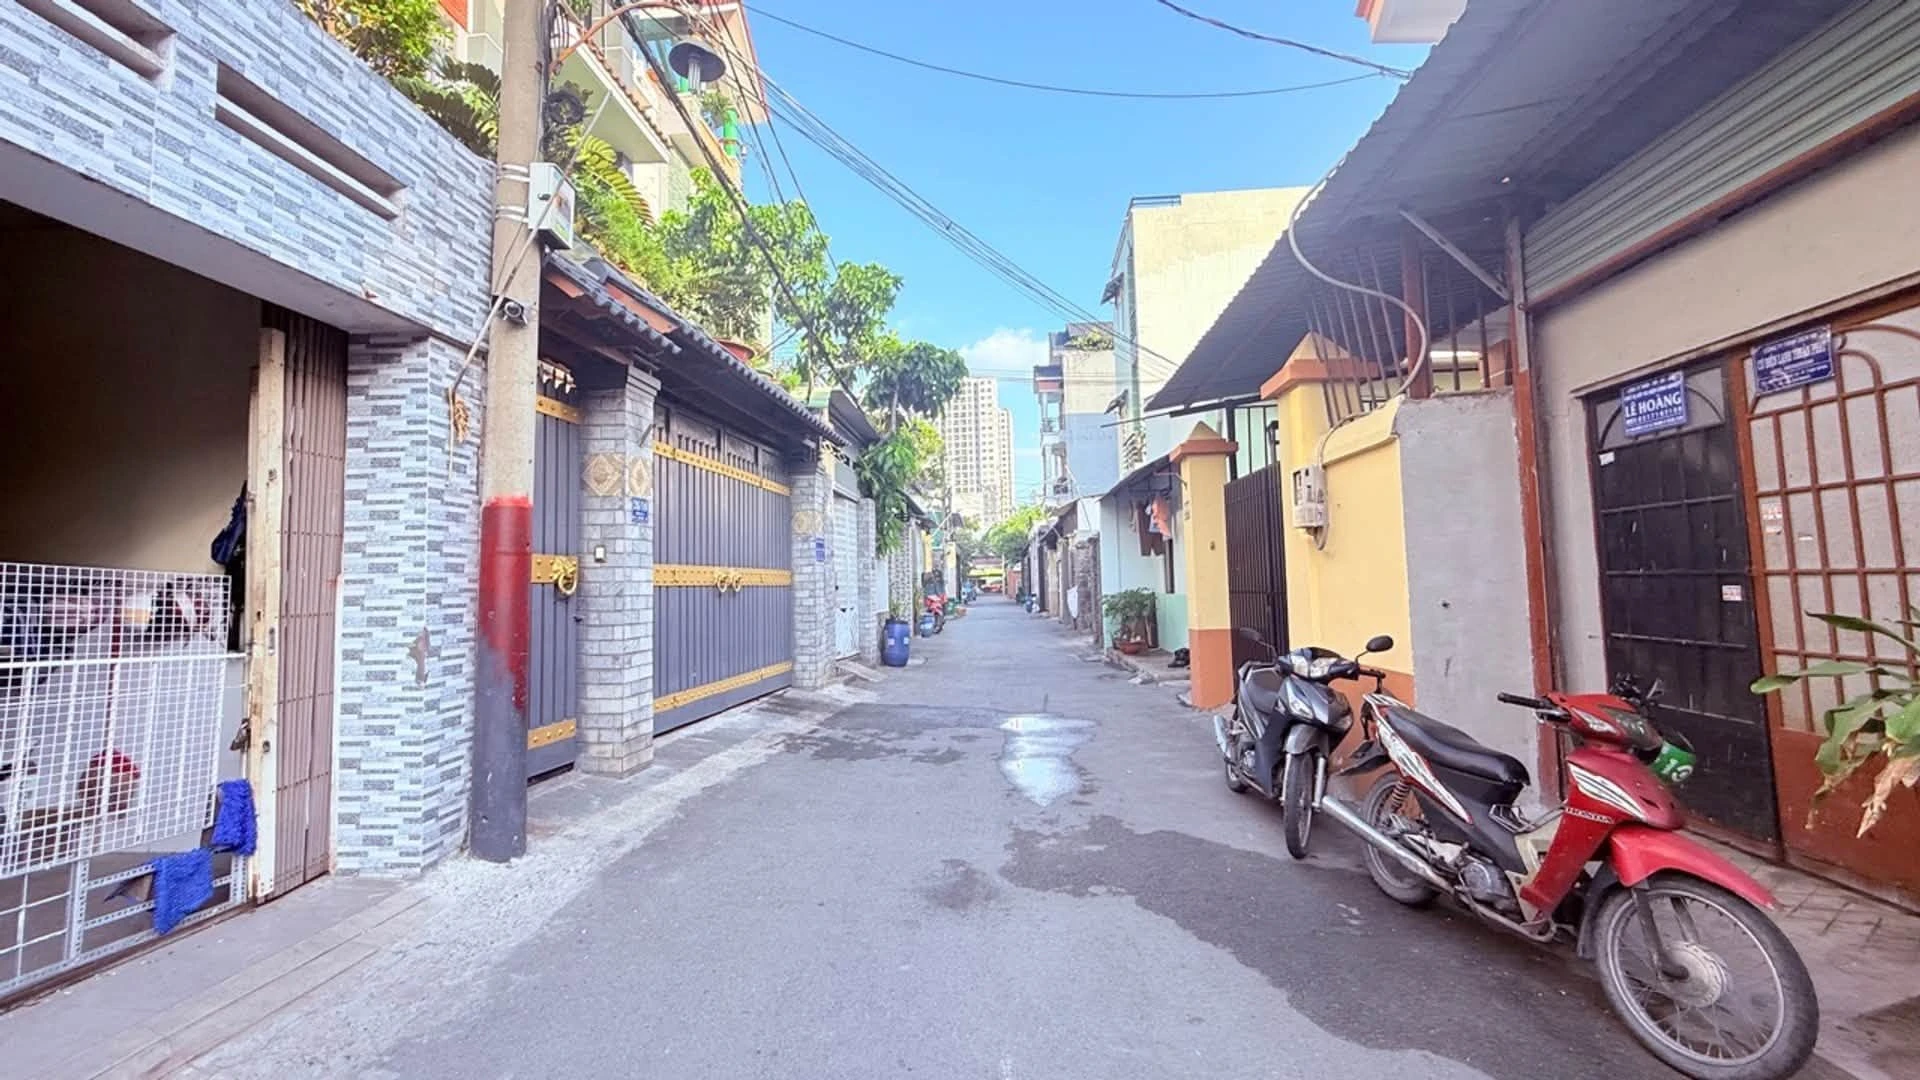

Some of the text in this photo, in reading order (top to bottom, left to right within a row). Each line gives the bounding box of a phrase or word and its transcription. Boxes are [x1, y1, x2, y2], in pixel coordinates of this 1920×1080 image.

[1624, 401, 1638, 418] LÊ
[1638, 391, 1682, 414] HOÀNG
[1565, 806, 1615, 825] HONDA
